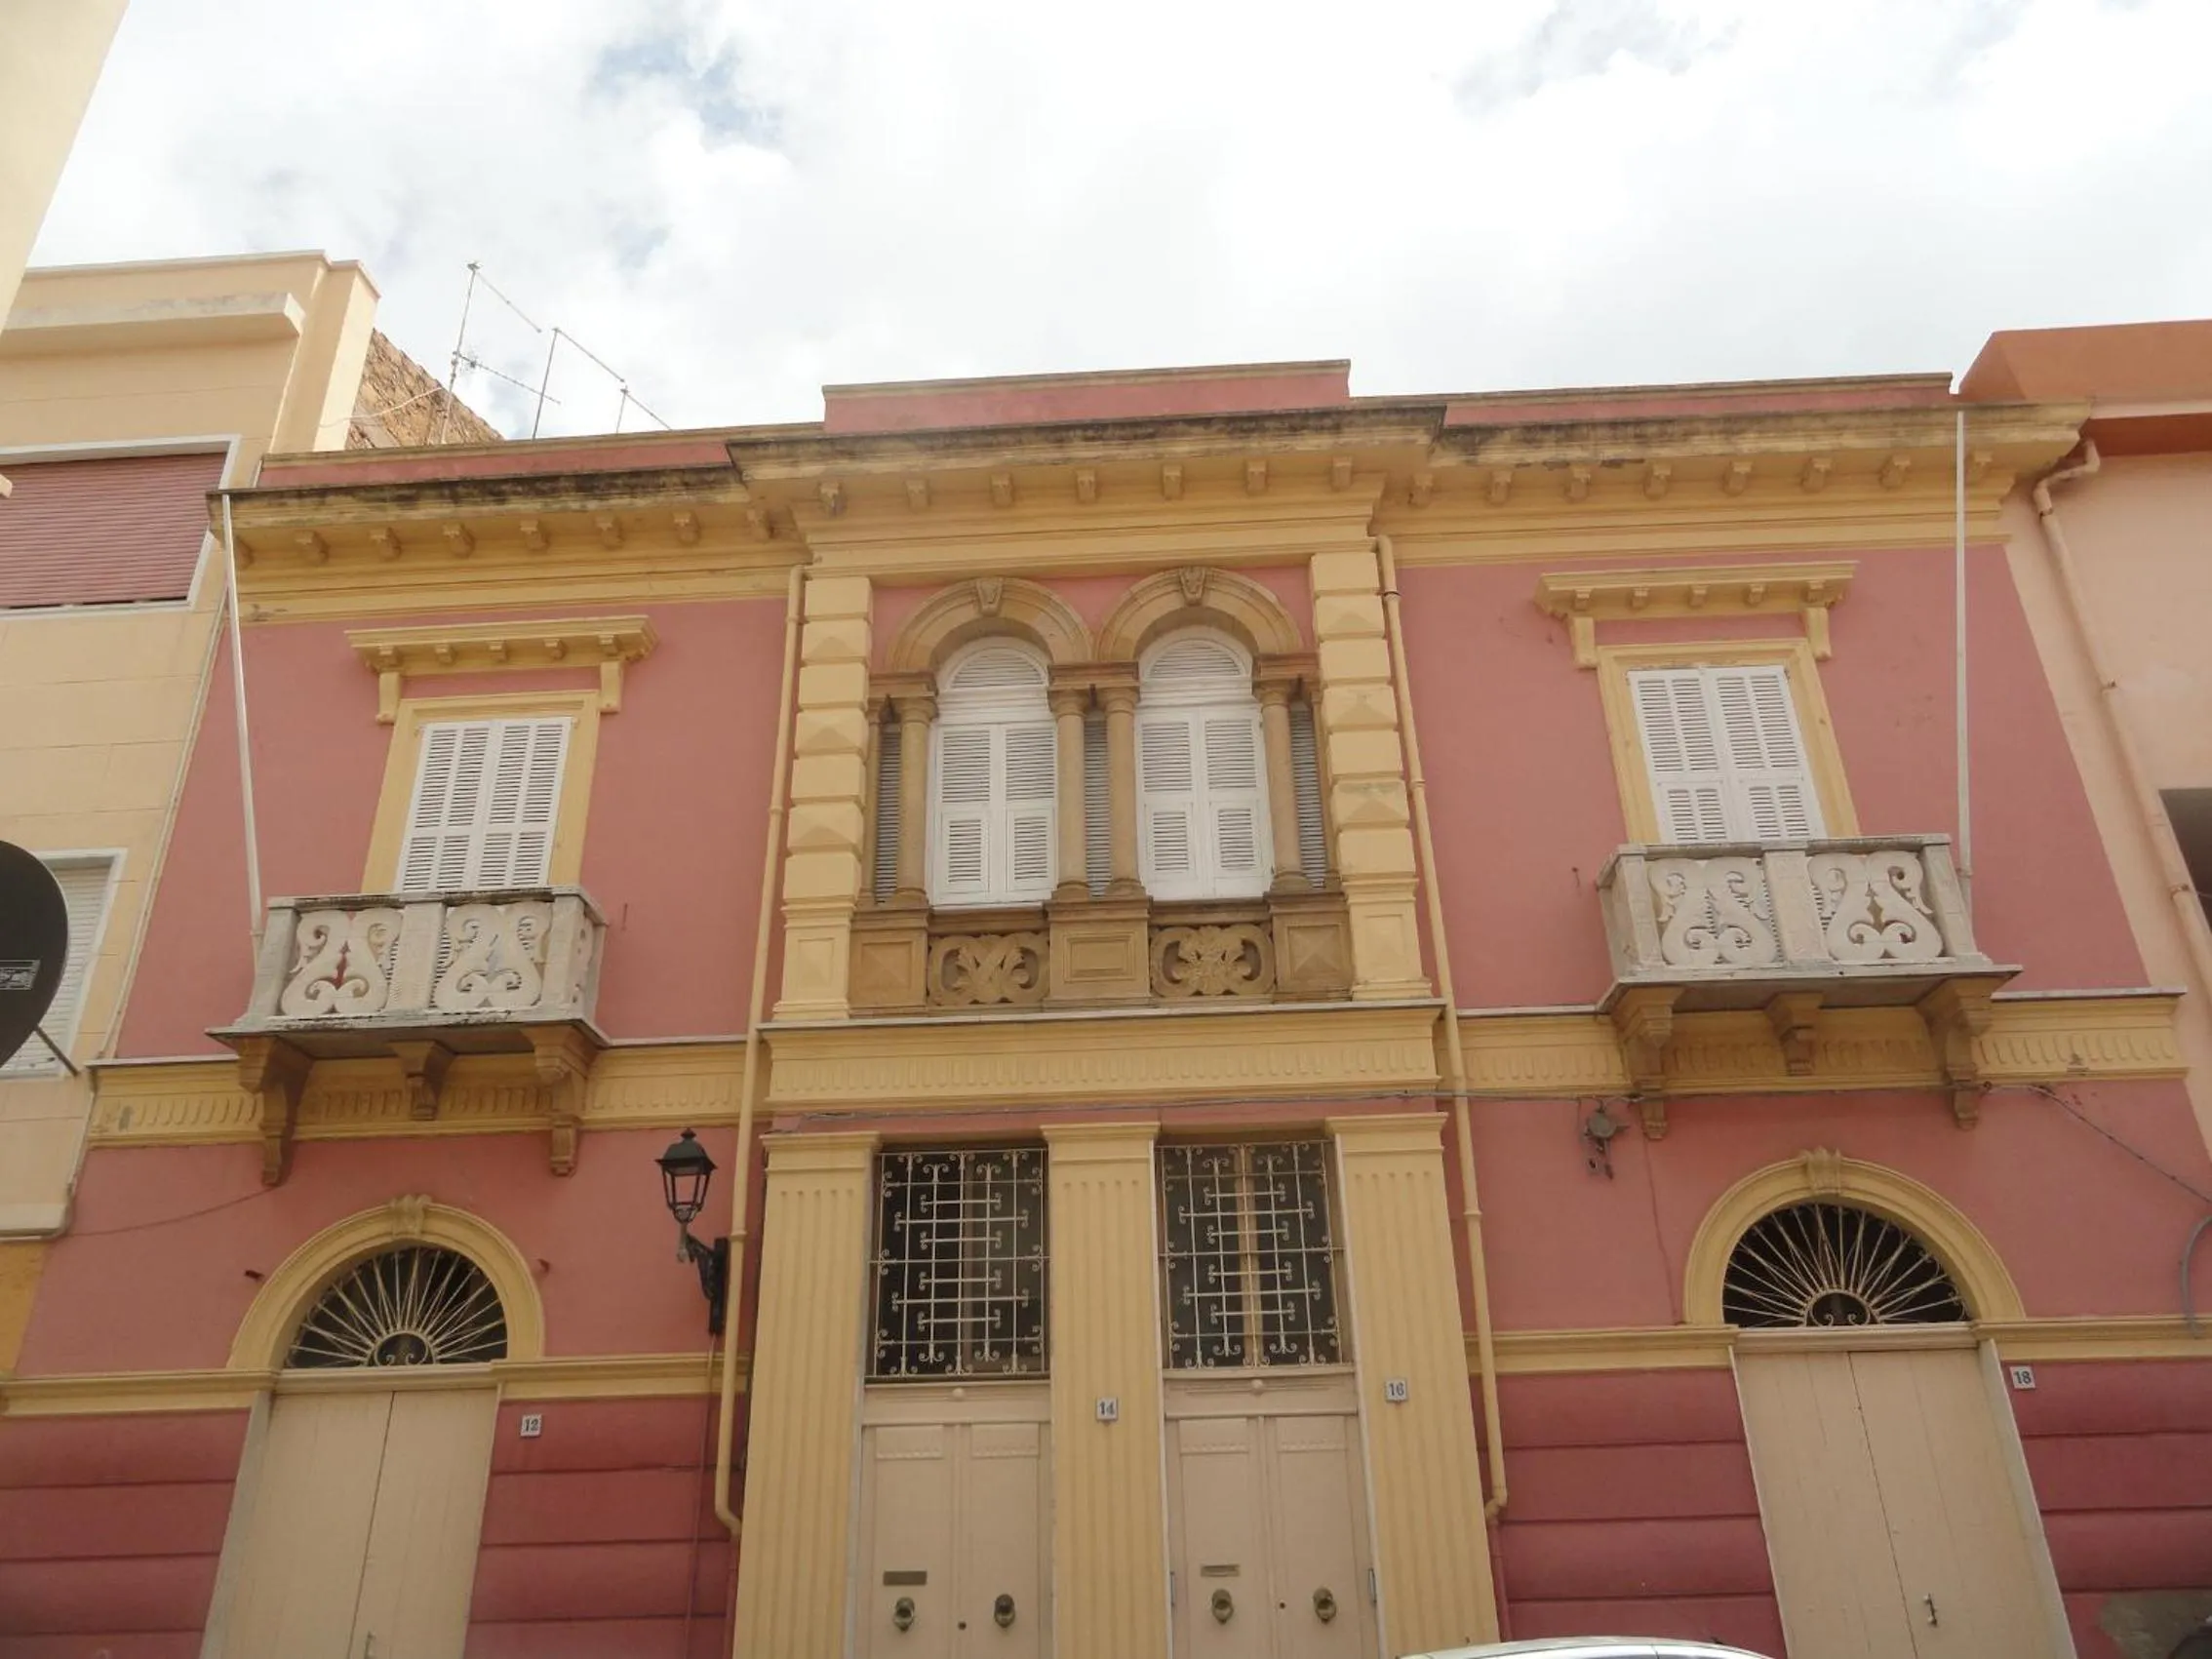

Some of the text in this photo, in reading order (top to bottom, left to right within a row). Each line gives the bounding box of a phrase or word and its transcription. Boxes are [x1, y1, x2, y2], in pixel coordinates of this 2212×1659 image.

[2013, 1370, 2032, 1384] 18
[1389, 1381, 1404, 1396] 16
[1099, 1401, 1115, 1415] 14
[525, 1418, 539, 1432] 12
